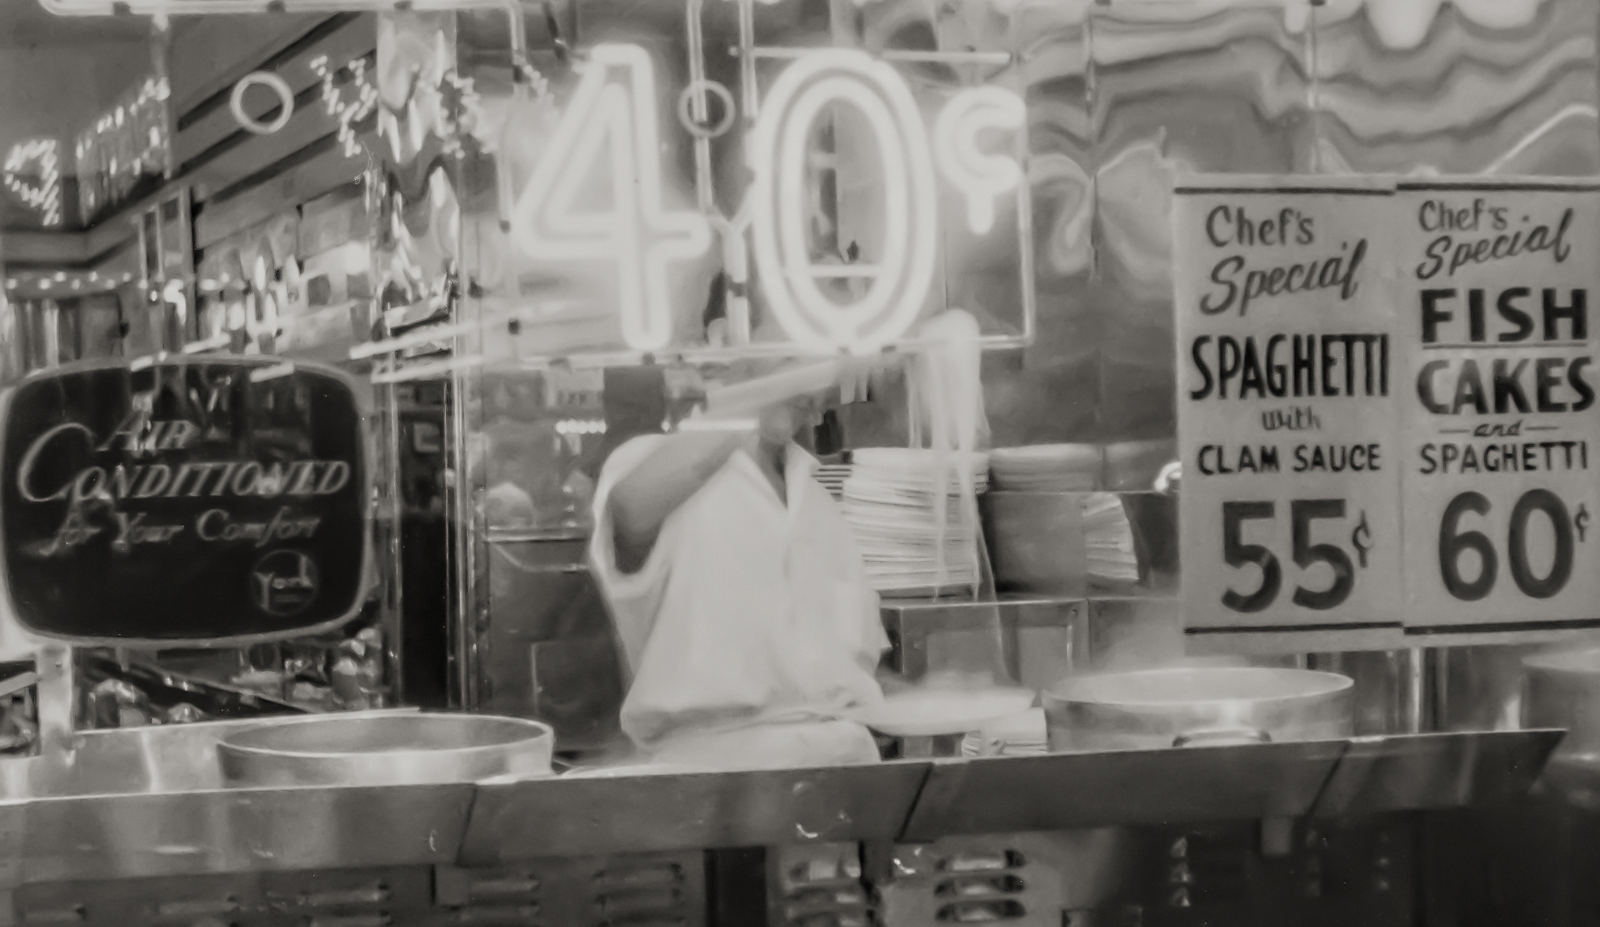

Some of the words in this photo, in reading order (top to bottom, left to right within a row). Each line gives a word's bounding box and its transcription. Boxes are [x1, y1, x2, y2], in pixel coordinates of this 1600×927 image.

[1206, 205, 1314, 247] Chef's
[1417, 199, 1508, 232] Chef's
[1416, 208, 1574, 280] Special
[1200, 238, 1369, 317] Special
[1419, 286, 1588, 343] FISH
[1190, 333, 1390, 400] SPAGHETTI
[1417, 356, 1596, 414] CAKES
[1262, 405, 1321, 431] with
[1473, 420, 1525, 438] and
[1198, 444, 1281, 475] CLAM
[1292, 443, 1382, 473] SAUCE
[1419, 440, 1589, 474] SPAGHETTI
